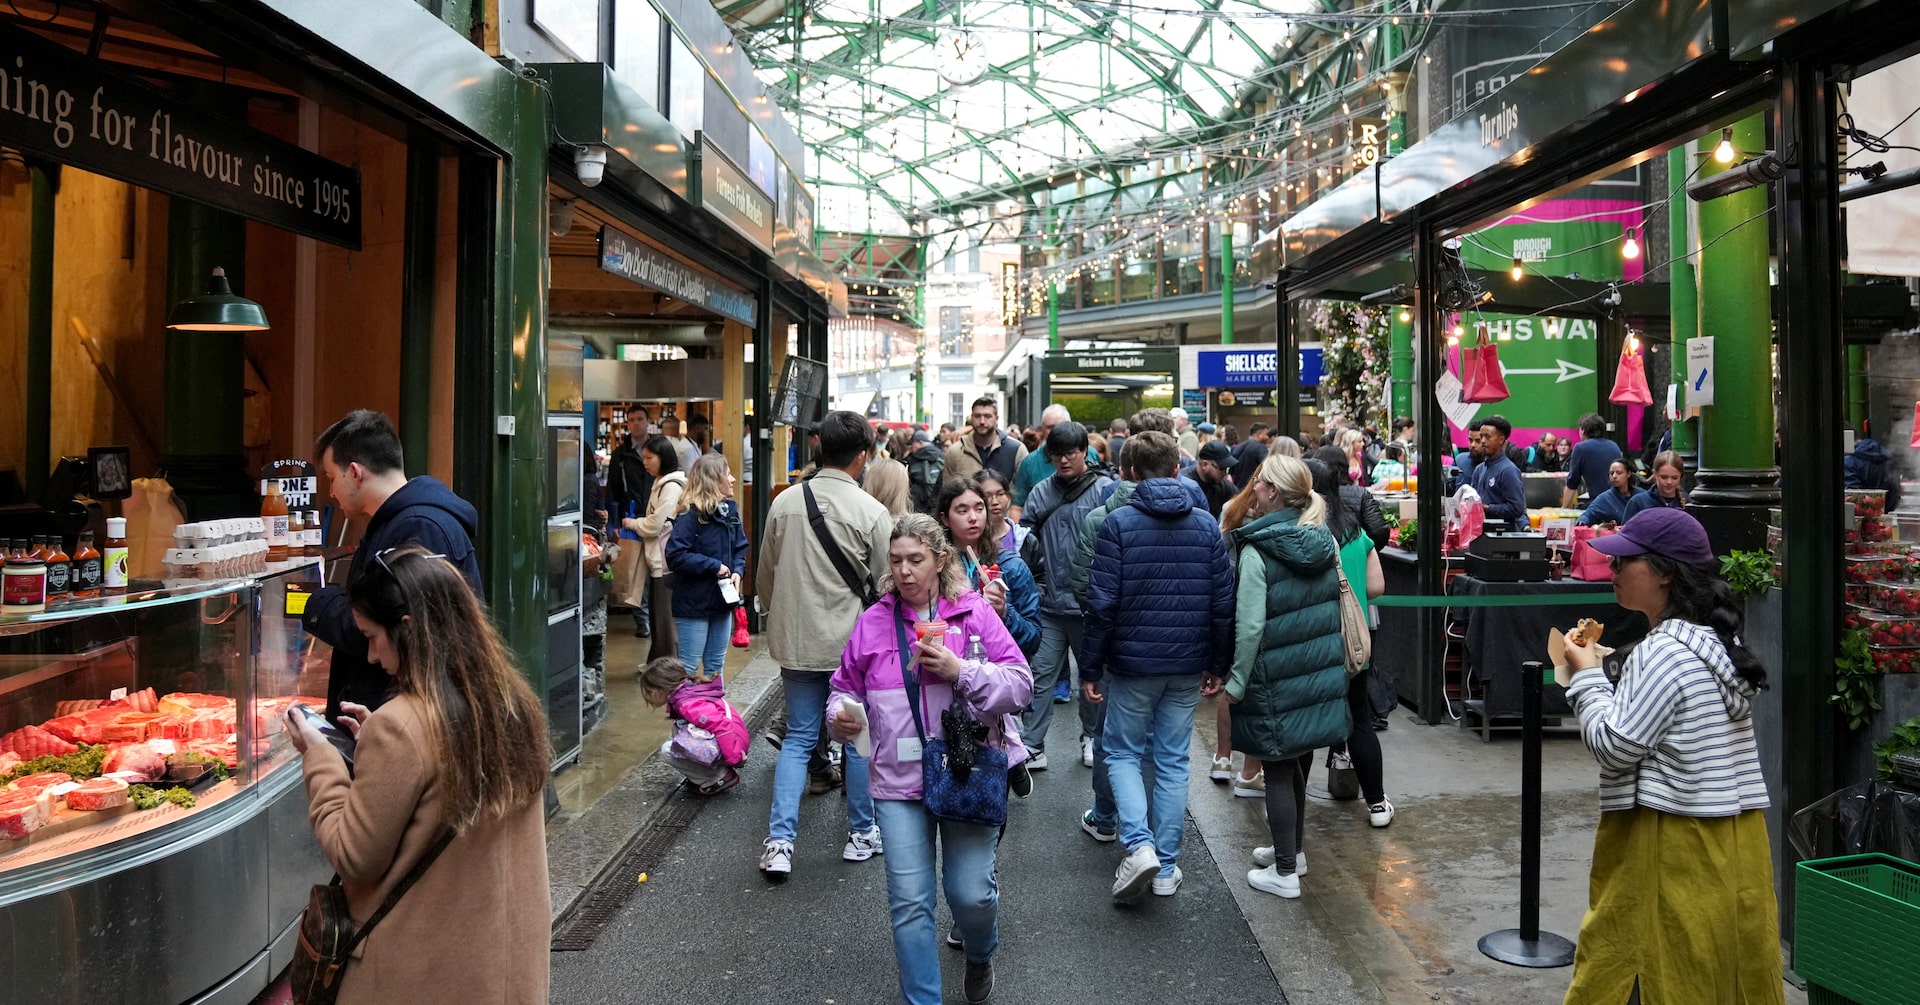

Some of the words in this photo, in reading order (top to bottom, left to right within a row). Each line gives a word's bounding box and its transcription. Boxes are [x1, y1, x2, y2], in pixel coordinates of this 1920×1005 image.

[1475, 73, 1524, 98] BO
[1480, 101, 1519, 149] Turnips
[90, 86, 136, 151] for
[150, 109, 243, 186] flavour
[253, 154, 305, 209] since
[312, 177, 351, 224] 1995
[735, 184, 746, 215] Fish
[746, 193, 763, 228] Markets
[1513, 237, 1552, 251] BOROUGH
[621, 240, 634, 278] Day
[633, 246, 649, 280] Boat
[1513, 250, 1547, 262] MARKET
[1106, 357, 1112, 367] &
[1113, 357, 1145, 368] Daughter
[1225, 353, 1304, 372] SHELLSEES
[1264, 374, 1304, 382] KITN
[273, 459, 307, 469] SPRING
[282, 478, 309, 492] ONE
[284, 493, 310, 508] OTH
